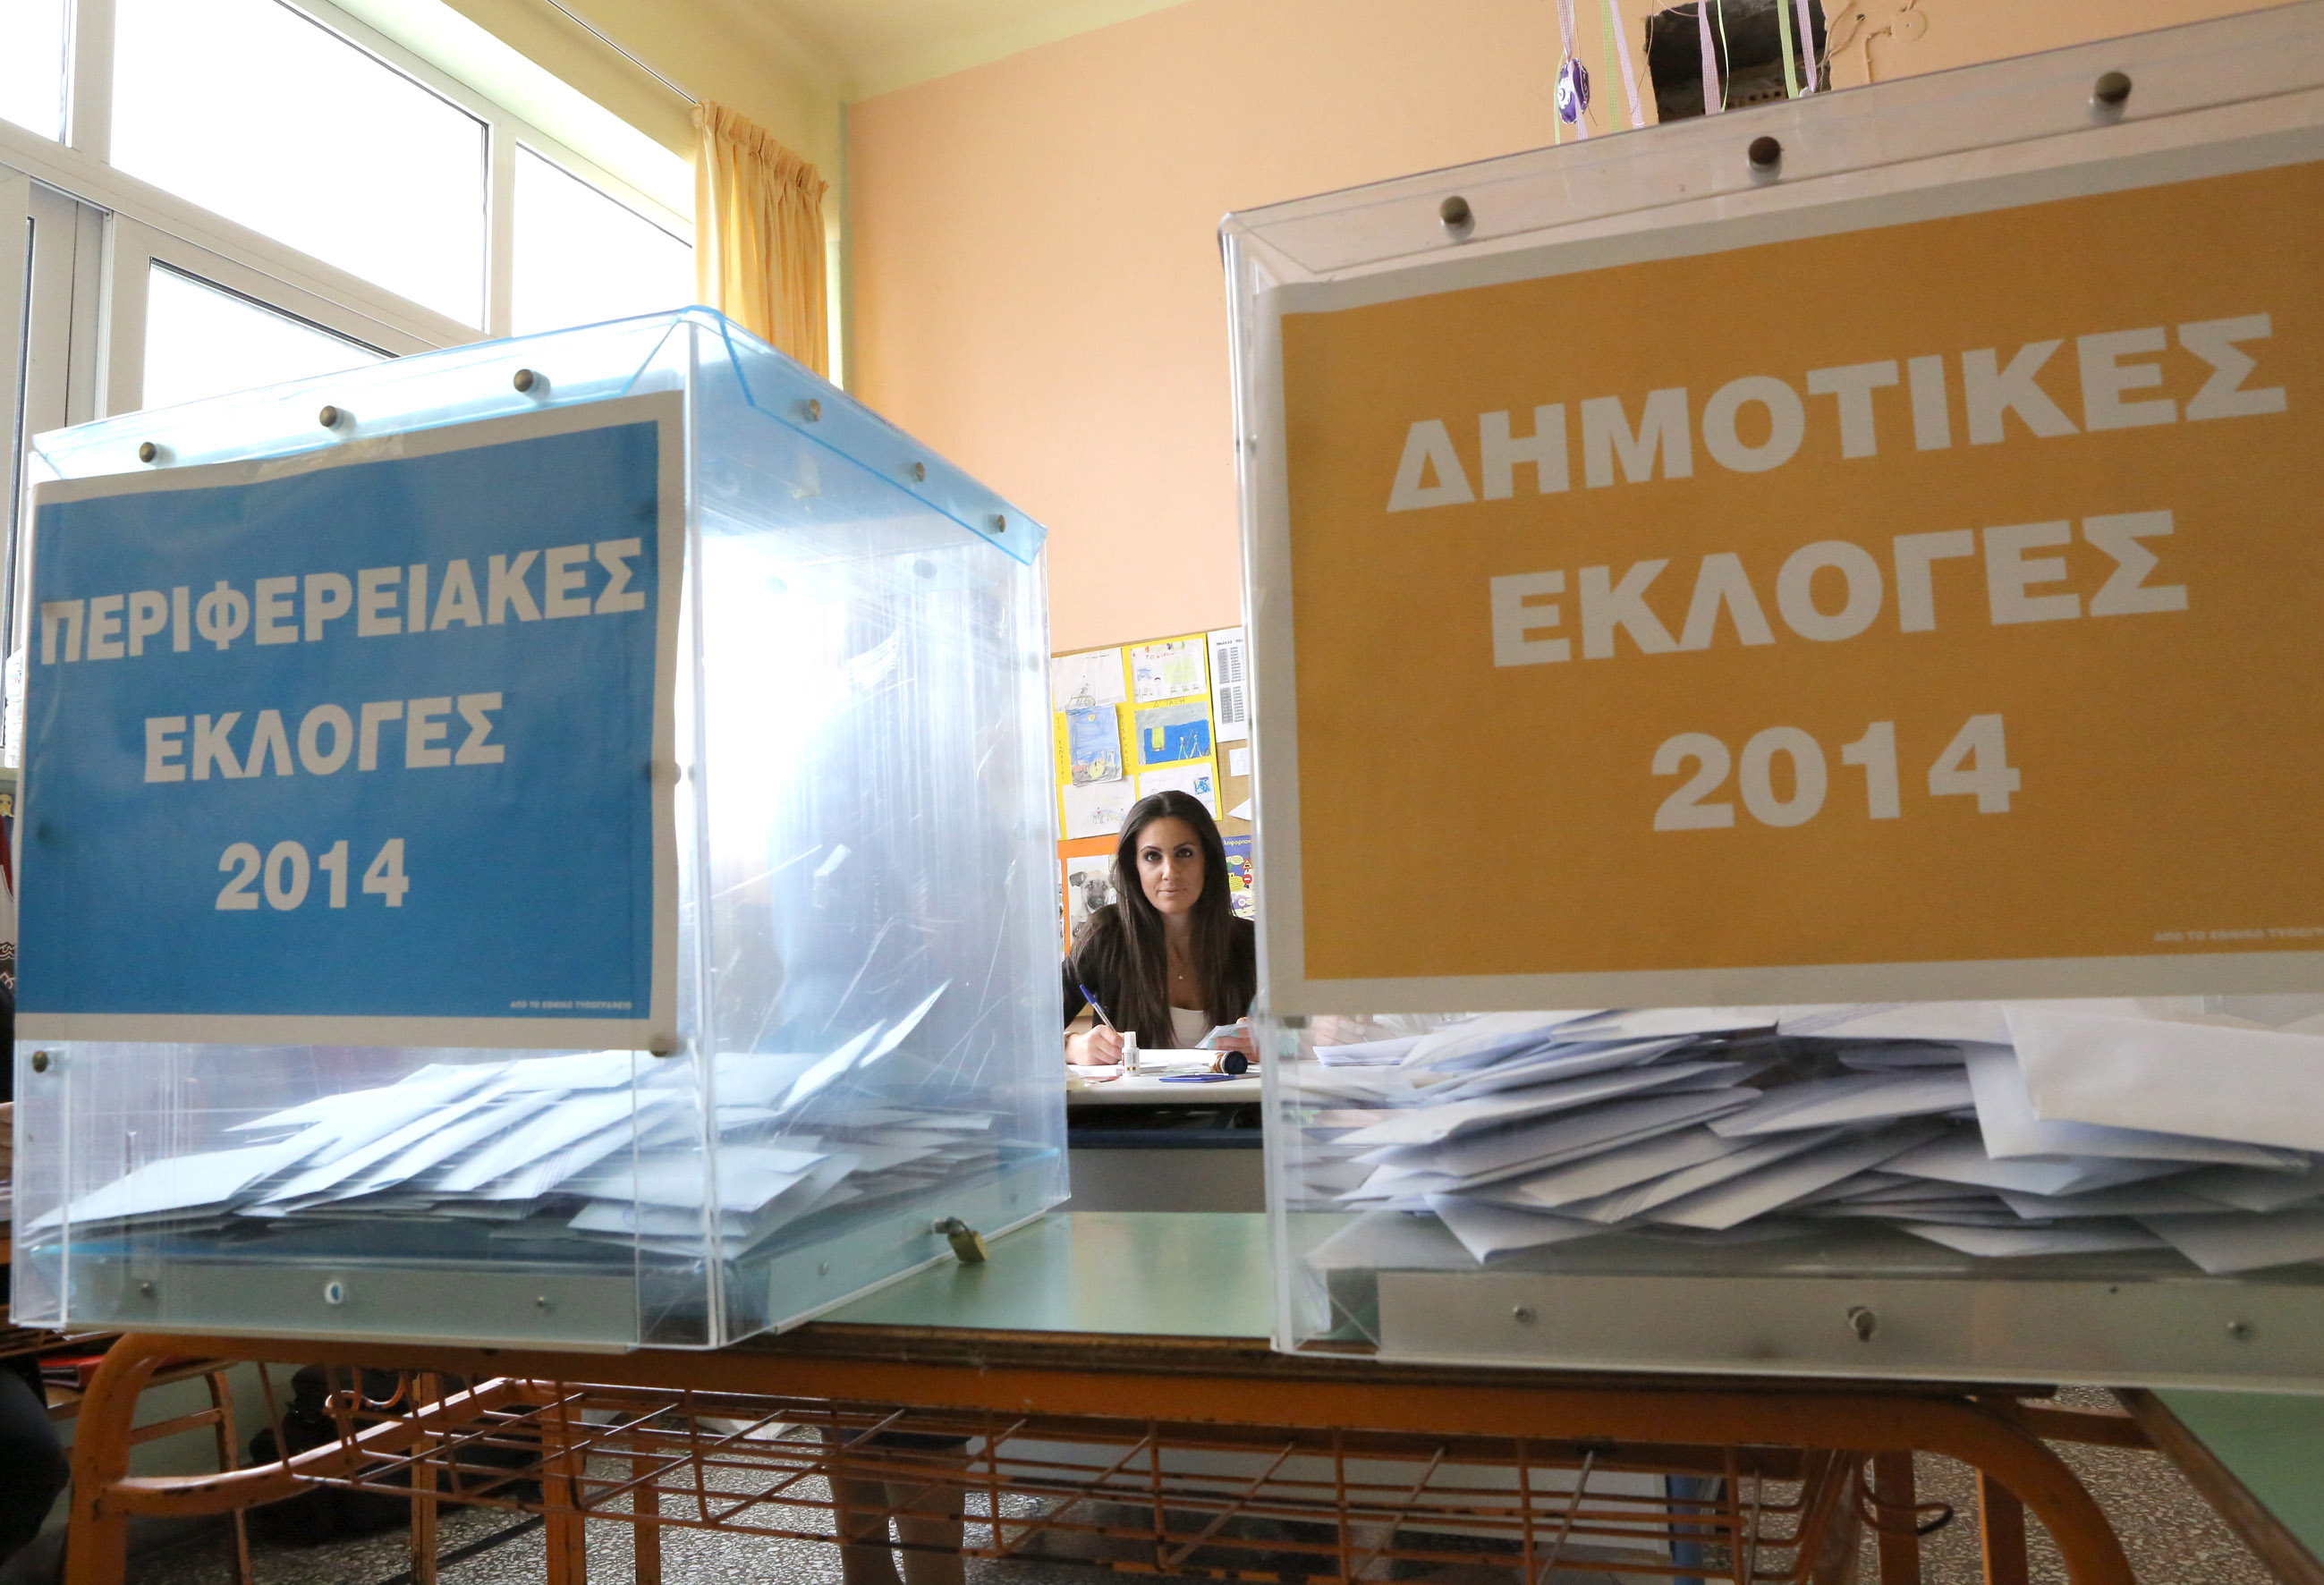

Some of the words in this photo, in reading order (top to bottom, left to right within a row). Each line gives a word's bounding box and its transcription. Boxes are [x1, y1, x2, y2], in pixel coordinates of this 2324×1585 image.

[1385, 312, 2288, 513] ΔΗΜΟΤΙΚΕΣ
[39, 537, 645, 666] ΠΕΡΙΦΕΡΕΙΑΚΕΣ
[1489, 508, 2190, 668] ΕΚΛΟΓΕΣ
[144, 691, 505, 784] ΕΚΛΟΓΕΣ
[1650, 712, 2022, 833] 2014
[215, 837, 410, 911] 2014
